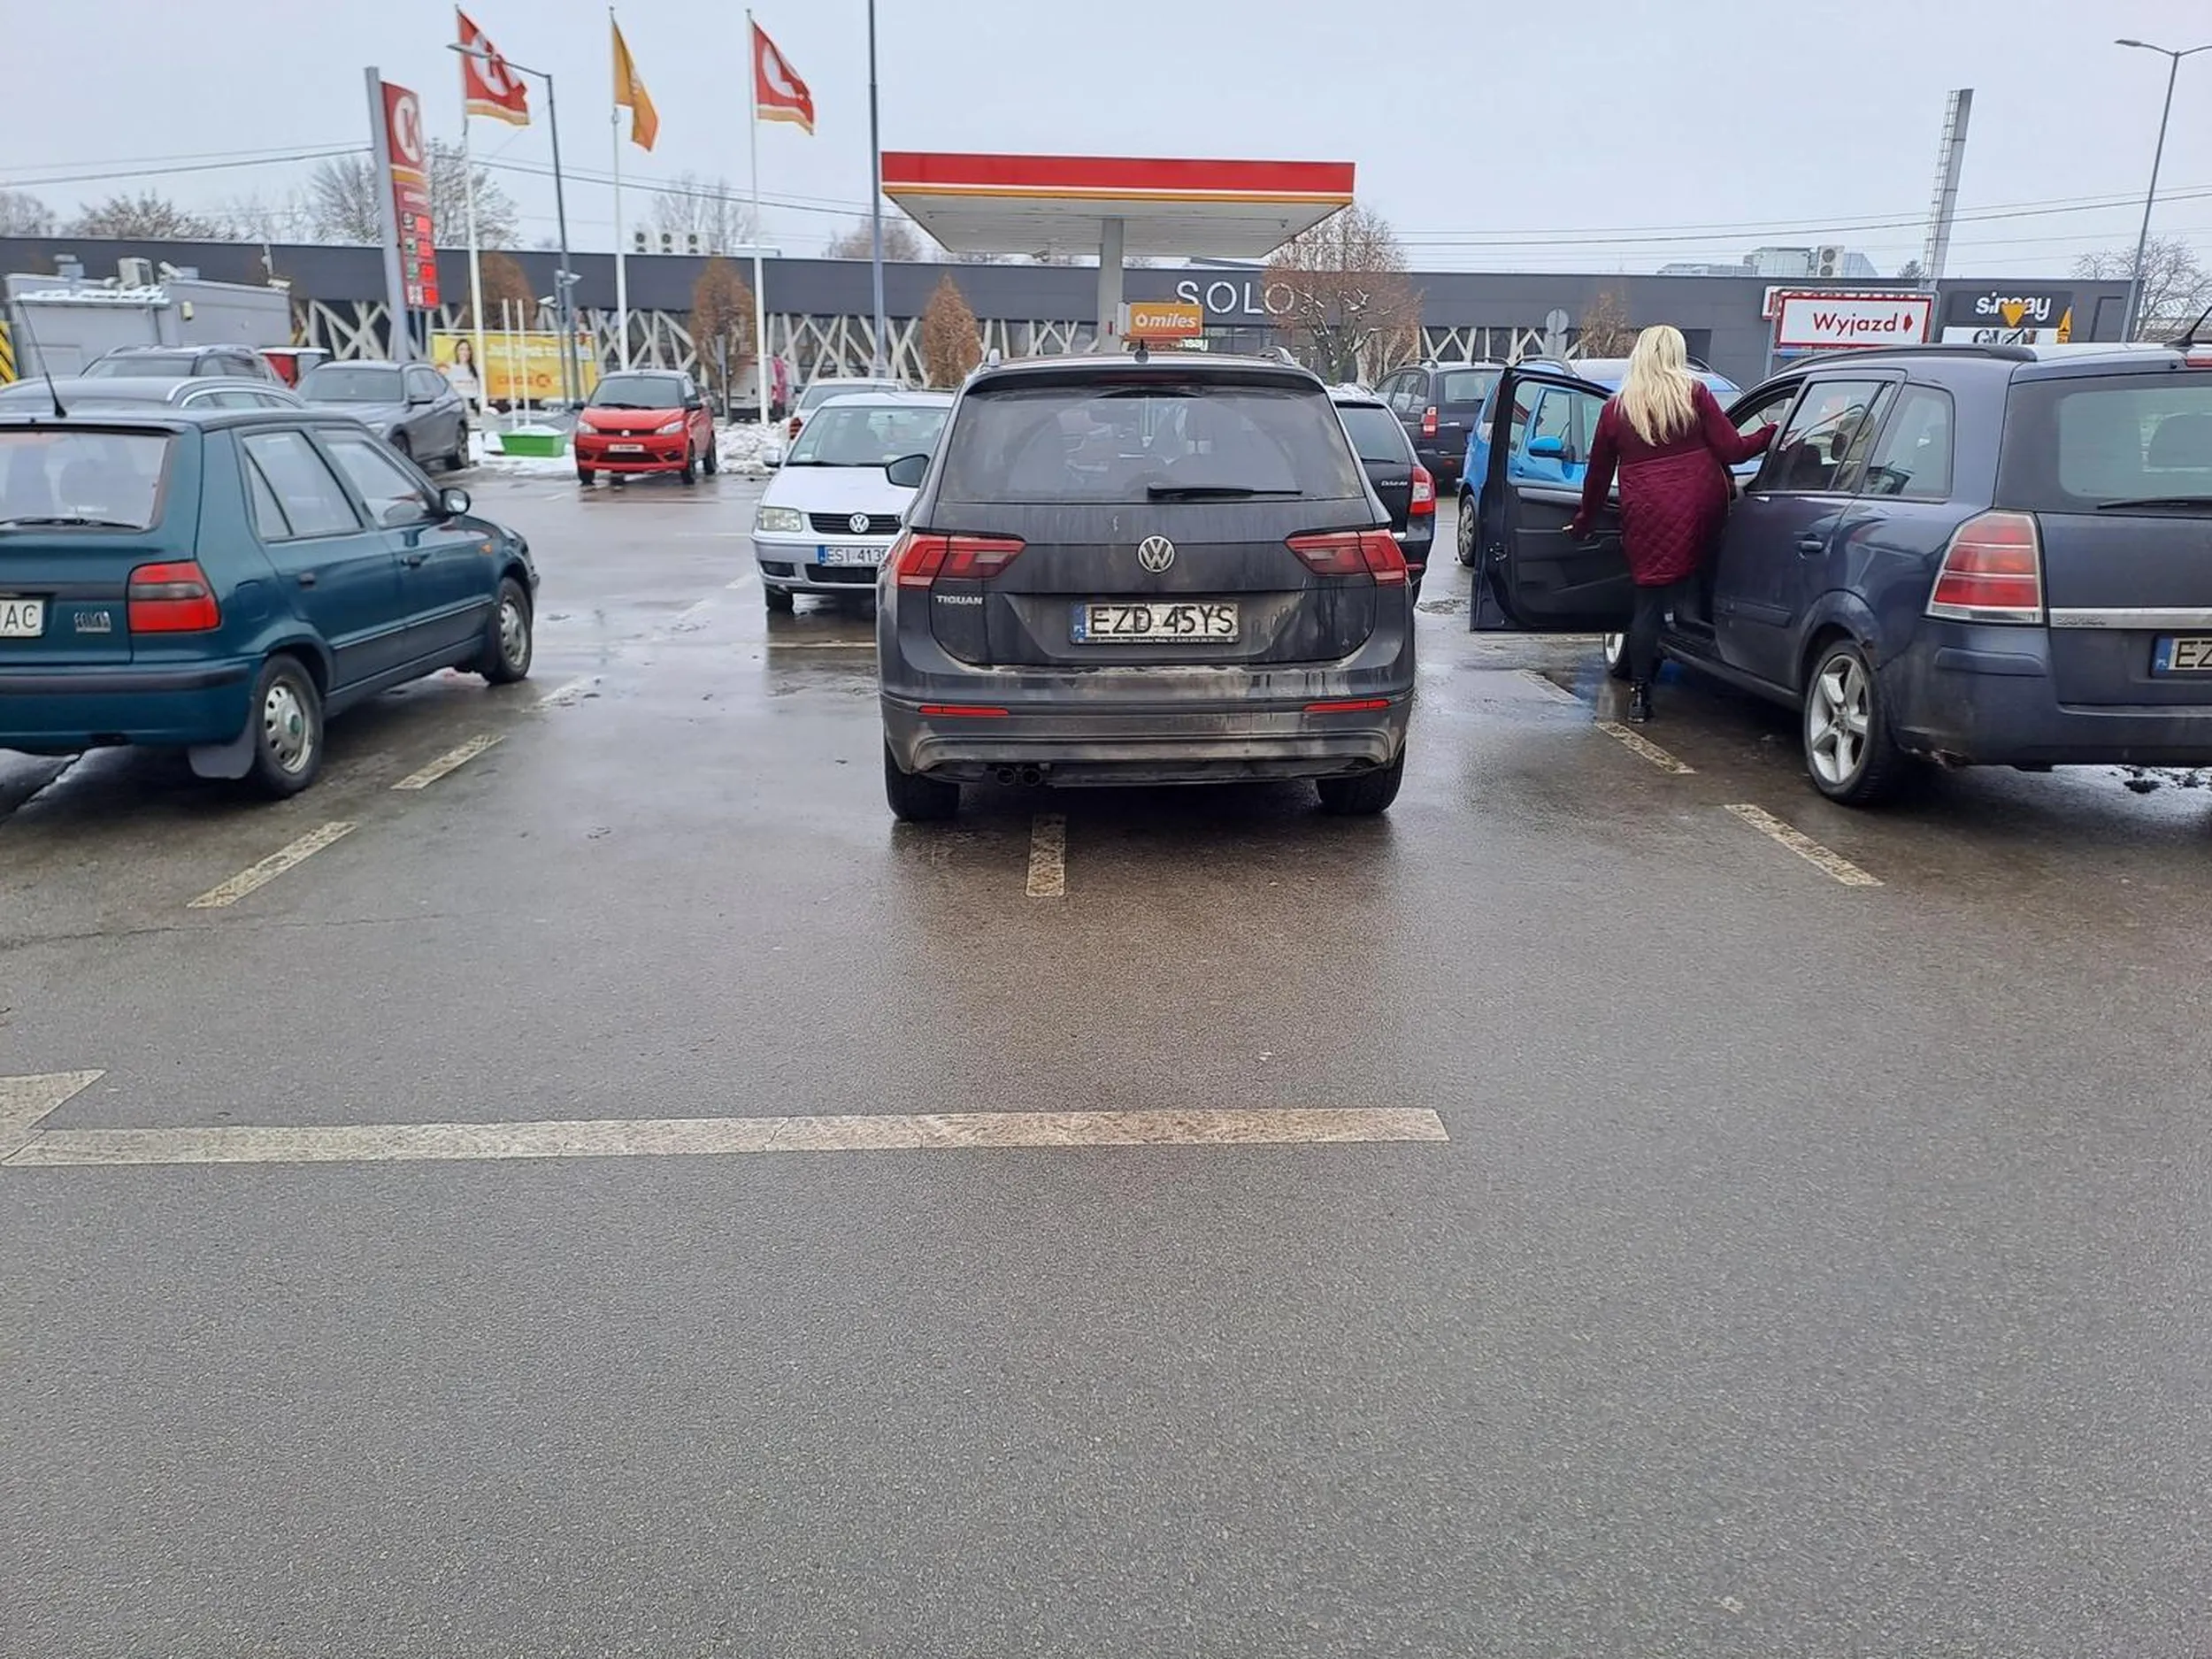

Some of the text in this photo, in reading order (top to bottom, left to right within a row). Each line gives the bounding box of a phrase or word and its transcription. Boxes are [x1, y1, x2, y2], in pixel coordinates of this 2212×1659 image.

[1176, 280, 1294, 314] SOLO
[1975, 291, 2051, 321] sinay
[1149, 312, 1197, 328] miles
[1813, 312, 1898, 336] Wyjazd
[826, 549, 850, 564] ESI
[936, 595, 984, 605] TIGUAN
[1091, 606, 1234, 634] EZD 45YS
[2175, 640, 2212, 668] EZ
